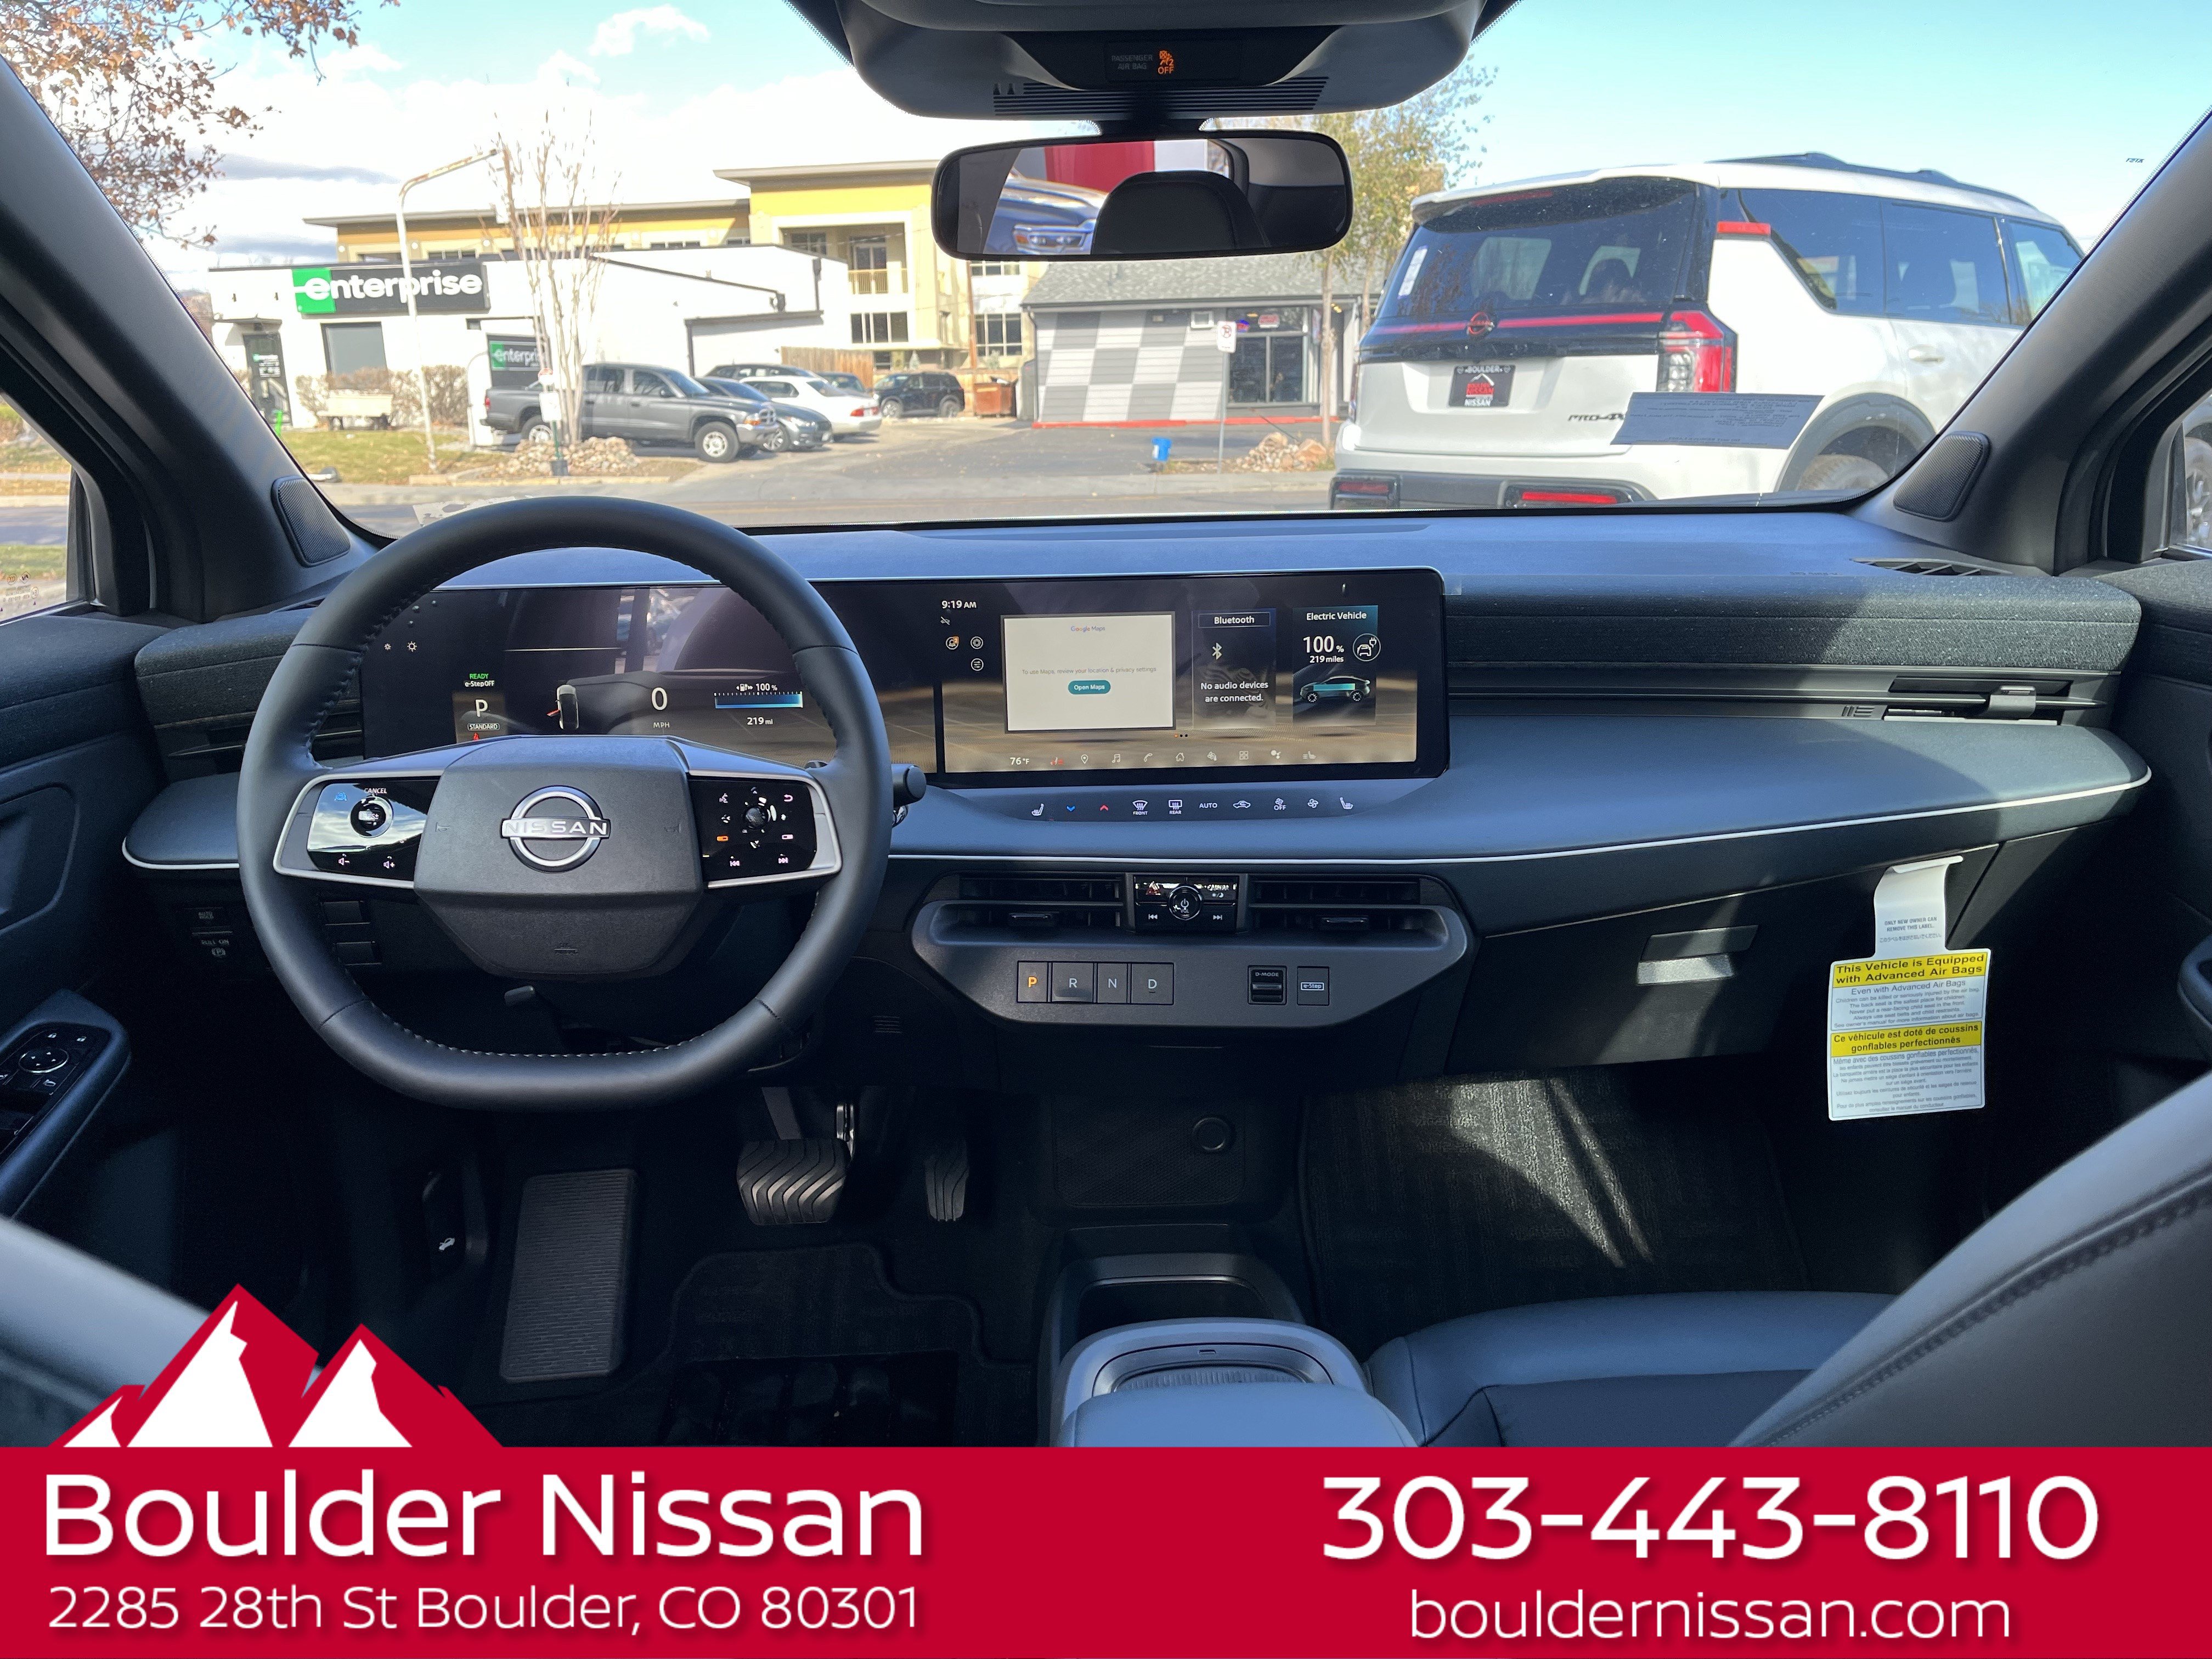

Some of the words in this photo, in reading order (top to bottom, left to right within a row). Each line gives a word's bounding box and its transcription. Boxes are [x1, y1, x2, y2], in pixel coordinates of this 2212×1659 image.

[303, 269, 483, 303] enterprise
[941, 600, 962, 609] 9:19
[1214, 616, 1255, 624] Bluetooth
[1306, 612, 1336, 620] Electric
[1338, 611, 1367, 620] Vehicle
[1214, 681, 1237, 690] audio
[1239, 680, 1268, 690] devices
[651, 687, 668, 710] 0
[1220, 693, 1264, 703] connected.
[475, 698, 488, 718] P
[747, 717, 764, 726] 219
[505, 821, 607, 835] NISSAN
[1837, 965, 1861, 974] This
[1866, 959, 1909, 972] Vehicle
[1912, 958, 1922, 967] is
[1927, 955, 1984, 966] Equipped
[1836, 974, 1860, 984] with
[1866, 969, 1925, 982] Advanced
[1930, 967, 1947, 976] Air
[1952, 966, 1982, 975] Bags
[1028, 977, 1037, 988] P
[1069, 978, 1078, 989] R
[1108, 978, 1117, 988] N
[1148, 979, 1158, 990] D
[1892, 983, 1931, 992] Advanced
[1946, 980, 1966, 988] Bags
[1834, 1034, 1846, 1043] Ce
[1848, 1029, 1885, 1042] véhicule
[1887, 1029, 1901, 1039] est
[1904, 1027, 1923, 1038] doté
[1926, 1025, 1936, 1035] de
[1939, 1023, 1979, 1034] coussins
[1851, 1043, 1897, 1054] gonflables
[1900, 1036, 1961, 1050] perfectionnés
[1880, 1053, 1905, 1062] coussins
[1906, 1051, 1937, 1060] gonflables
